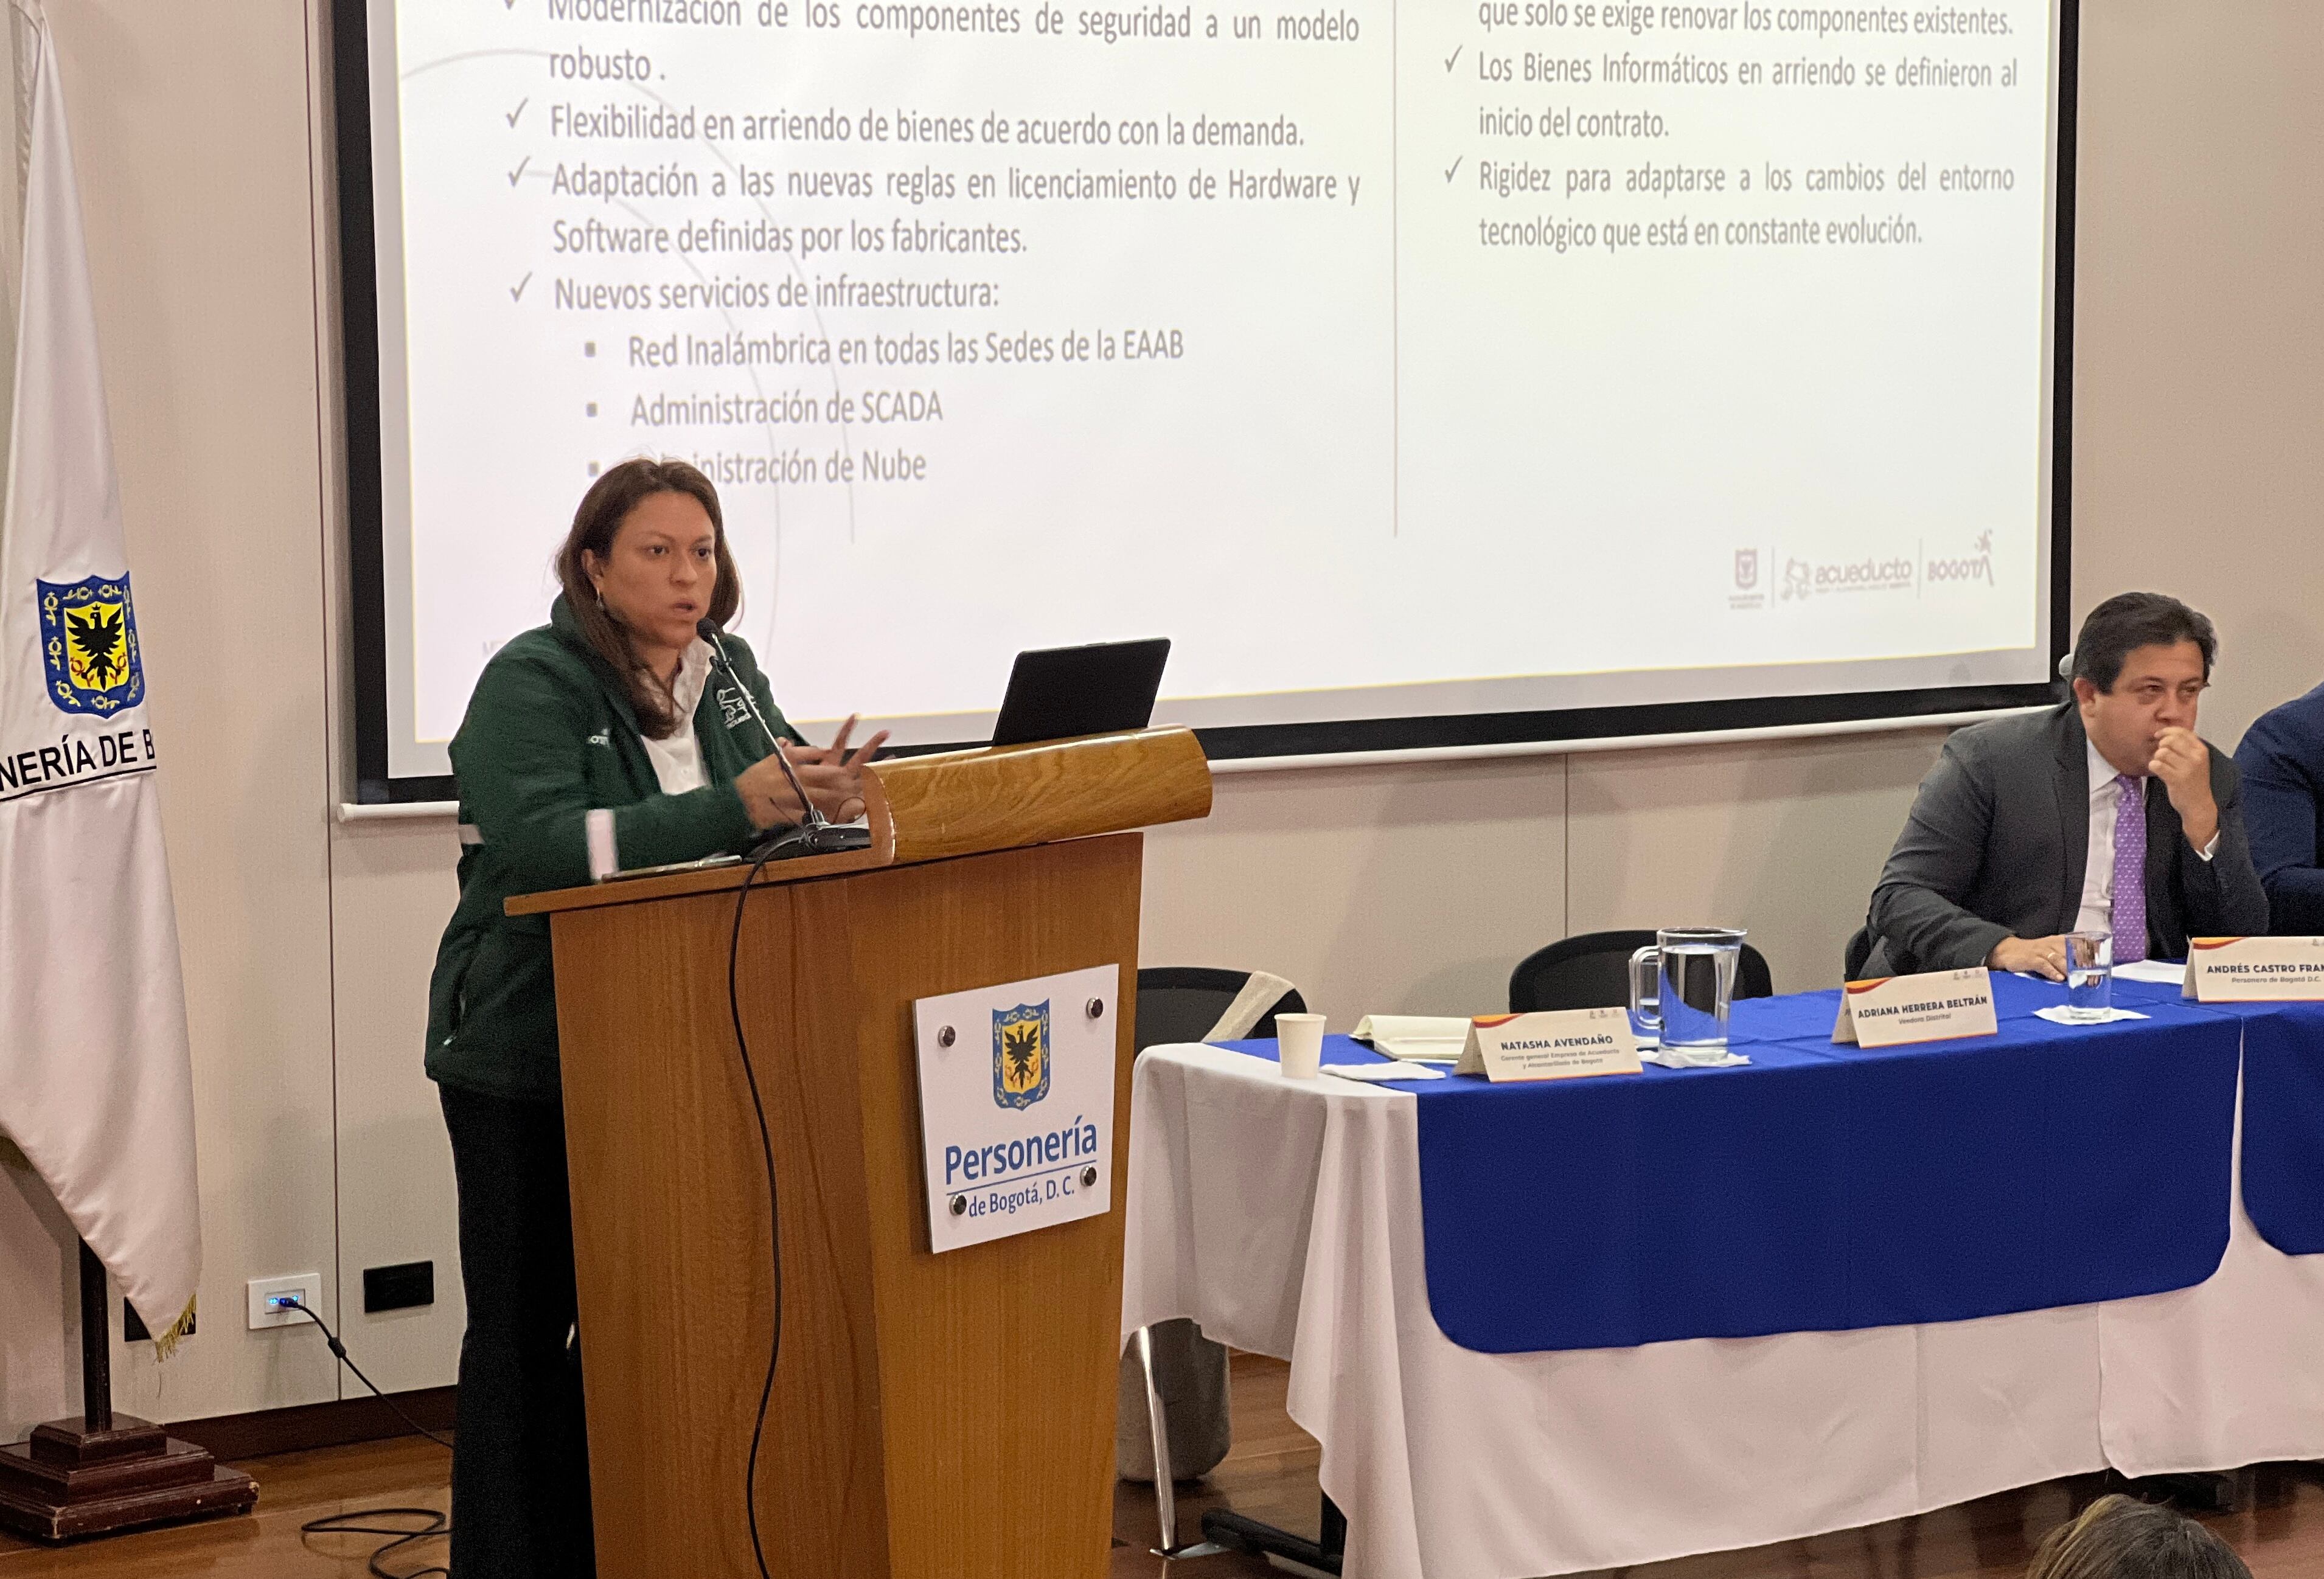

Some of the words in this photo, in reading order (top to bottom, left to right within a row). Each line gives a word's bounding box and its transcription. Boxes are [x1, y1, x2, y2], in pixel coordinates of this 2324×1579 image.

[758, 0, 788, 27] de
[806, 0, 840, 28] los
[857, 3, 1020, 38] componentes
[1035, 2, 1063, 35] de
[1079, 4, 1190, 44] seguridad
[1206, 15, 1217, 38] a
[1234, 16, 1261, 39] un
[1278, 9, 1359, 41] modelo
[1479, 3, 1518, 32] que
[1525, 0, 1567, 26] solo
[1574, 4, 1595, 27] se
[1603, 0, 1654, 35] exige
[1661, 7, 1738, 30] renovar
[1744, 1, 1771, 30] los
[1778, 6, 1907, 38] componentes
[1914, 5, 2012, 35] existentes.
[1480, 51, 1512, 82] Los
[1525, 52, 1592, 82] Bienes
[1604, 52, 1728, 84] Informáticos
[1739, 63, 1761, 85] en
[1773, 56, 1855, 85] arriendo
[1866, 64, 1885, 86] se
[1896, 57, 1991, 86] definieron
[2002, 58, 2016, 86] al
[552, 103, 695, 139] Flexibilidad
[704, 115, 734, 140] en
[743, 107, 851, 141] arriendo
[859, 108, 888, 141] de
[897, 108, 973, 142] bienes
[981, 111, 1009, 143] de
[1017, 113, 1111, 145] acuerdo
[1119, 121, 1158, 145] con
[1167, 113, 1185, 145] la
[1193, 114, 1303, 145] demanda.
[1480, 106, 1533, 137] inicio
[1540, 107, 1570, 137] del
[1577, 110, 1668, 137] contrato.
[552, 162, 697, 203] Adaptación
[712, 173, 725, 197] a
[740, 164, 774, 197] las
[788, 172, 872, 198] nuevas
[887, 165, 955, 204] reglas
[968, 175, 995, 199] en
[1009, 167, 1176, 200] licenciamiento
[1189, 168, 1216, 200] de
[1230, 168, 1337, 200] Hardware
[1348, 176, 1360, 206] y
[1481, 161, 1550, 198] Rigidez
[1567, 170, 1610, 199] para
[1627, 161, 1725, 198] adaptarse
[1740, 170, 1750, 190] a
[1766, 162, 1792, 191] los
[1806, 162, 1884, 191] cambios
[1898, 162, 1926, 190] del
[1940, 165, 2014, 191] entorno
[554, 218, 669, 253] Software
[678, 218, 793, 253] definidas
[802, 228, 843, 259] por
[852, 219, 884, 252] los
[892, 218, 1026, 253] fabricantes.
[1480, 216, 1596, 254] tecnológico
[1604, 223, 1640, 253] que
[1647, 215, 1687, 245] está
[1695, 223, 1718, 245] en
[1725, 218, 1820, 245] constante
[1826, 214, 1921, 243] evolución.
[556, 279, 651, 309] Nuevos
[660, 276, 769, 309] servicios
[778, 274, 807, 307] de
[816, 274, 998, 307] infraestructura:
[630, 334, 677, 367] Red
[687, 331, 830, 366] Inalámbrica
[839, 340, 866, 364] en
[875, 332, 939, 365] todas
[948, 331, 978, 363] las
[986, 331, 1054, 363] Sedes
[1062, 330, 1089, 361] de
[1098, 329, 1115, 361] la
[1124, 330, 1183, 359] EAAB
[631, 389, 818, 426] Administración
[827, 389, 854, 423] de
[862, 391, 942, 423] SCADA
[692, 450, 817, 484] nistración
[826, 450, 854, 482] de
[863, 448, 925, 481] Nube
[1815, 557, 1912, 585] acueducto
[99, 731, 137, 767] DE
[2207, 962, 2250, 973] ANDRÉS
[2253, 964, 2296, 973] CASTRO
[1858, 1007, 1899, 1018] ADRIANA
[1902, 1001, 1944, 1013] HERRERA
[1947, 994, 1988, 1008] BELTRÁN
[1501, 1040, 1551, 1050] NATASHA
[1554, 1033, 1613, 1047] AVENDAÑO
[945, 1114, 1097, 1185] Personería
[969, 1195, 986, 1217] de
[990, 1181, 1043, 1215] Bogotá,
